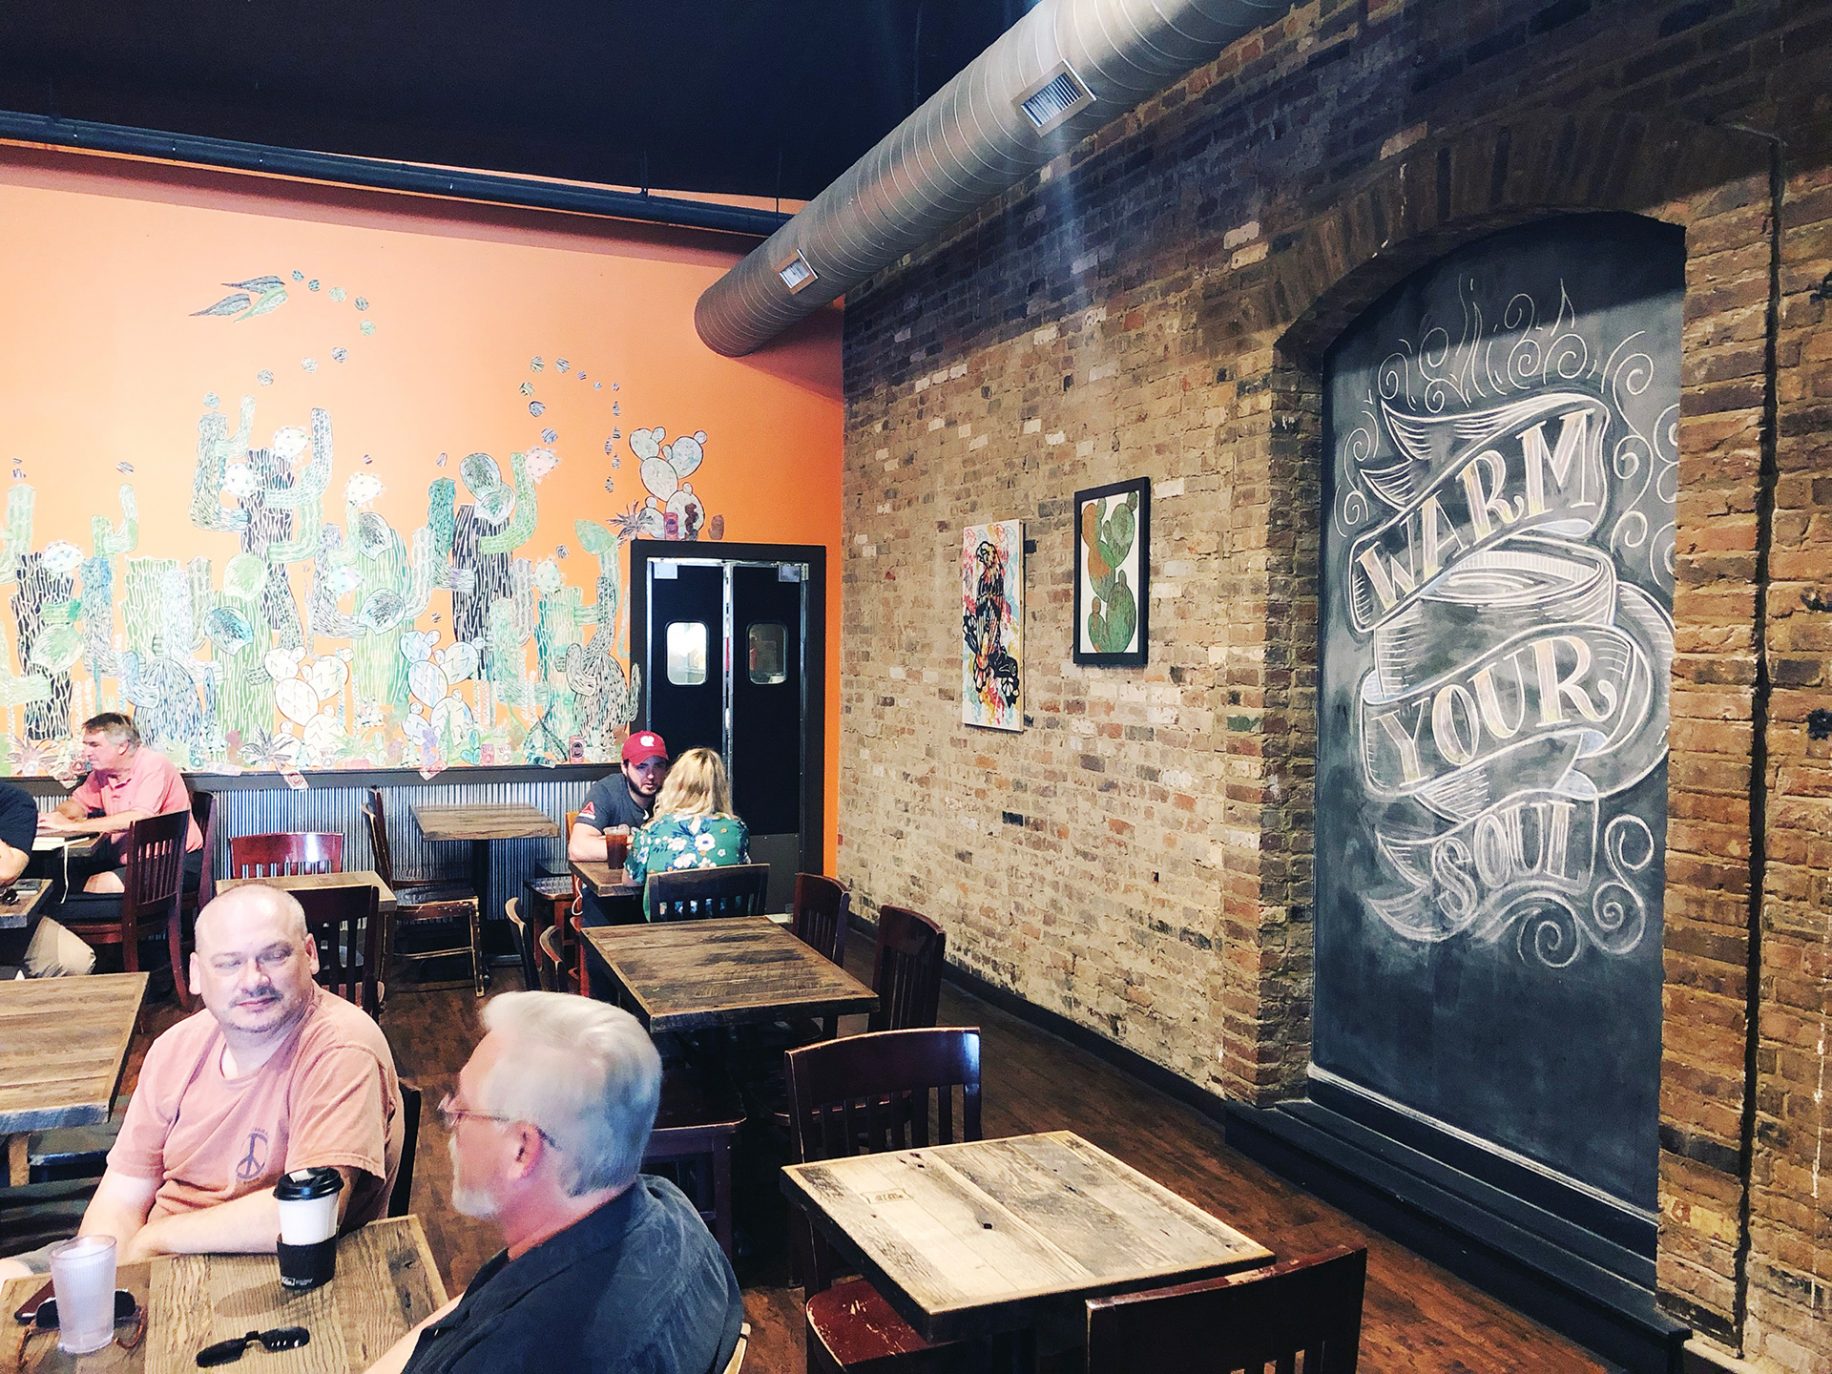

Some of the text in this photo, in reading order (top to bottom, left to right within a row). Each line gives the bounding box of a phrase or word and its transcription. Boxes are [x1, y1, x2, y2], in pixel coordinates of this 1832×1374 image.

[1355, 408, 1596, 611] WARM
[1371, 635, 1617, 788] YOUR
[1431, 800, 1584, 922] SOUL
